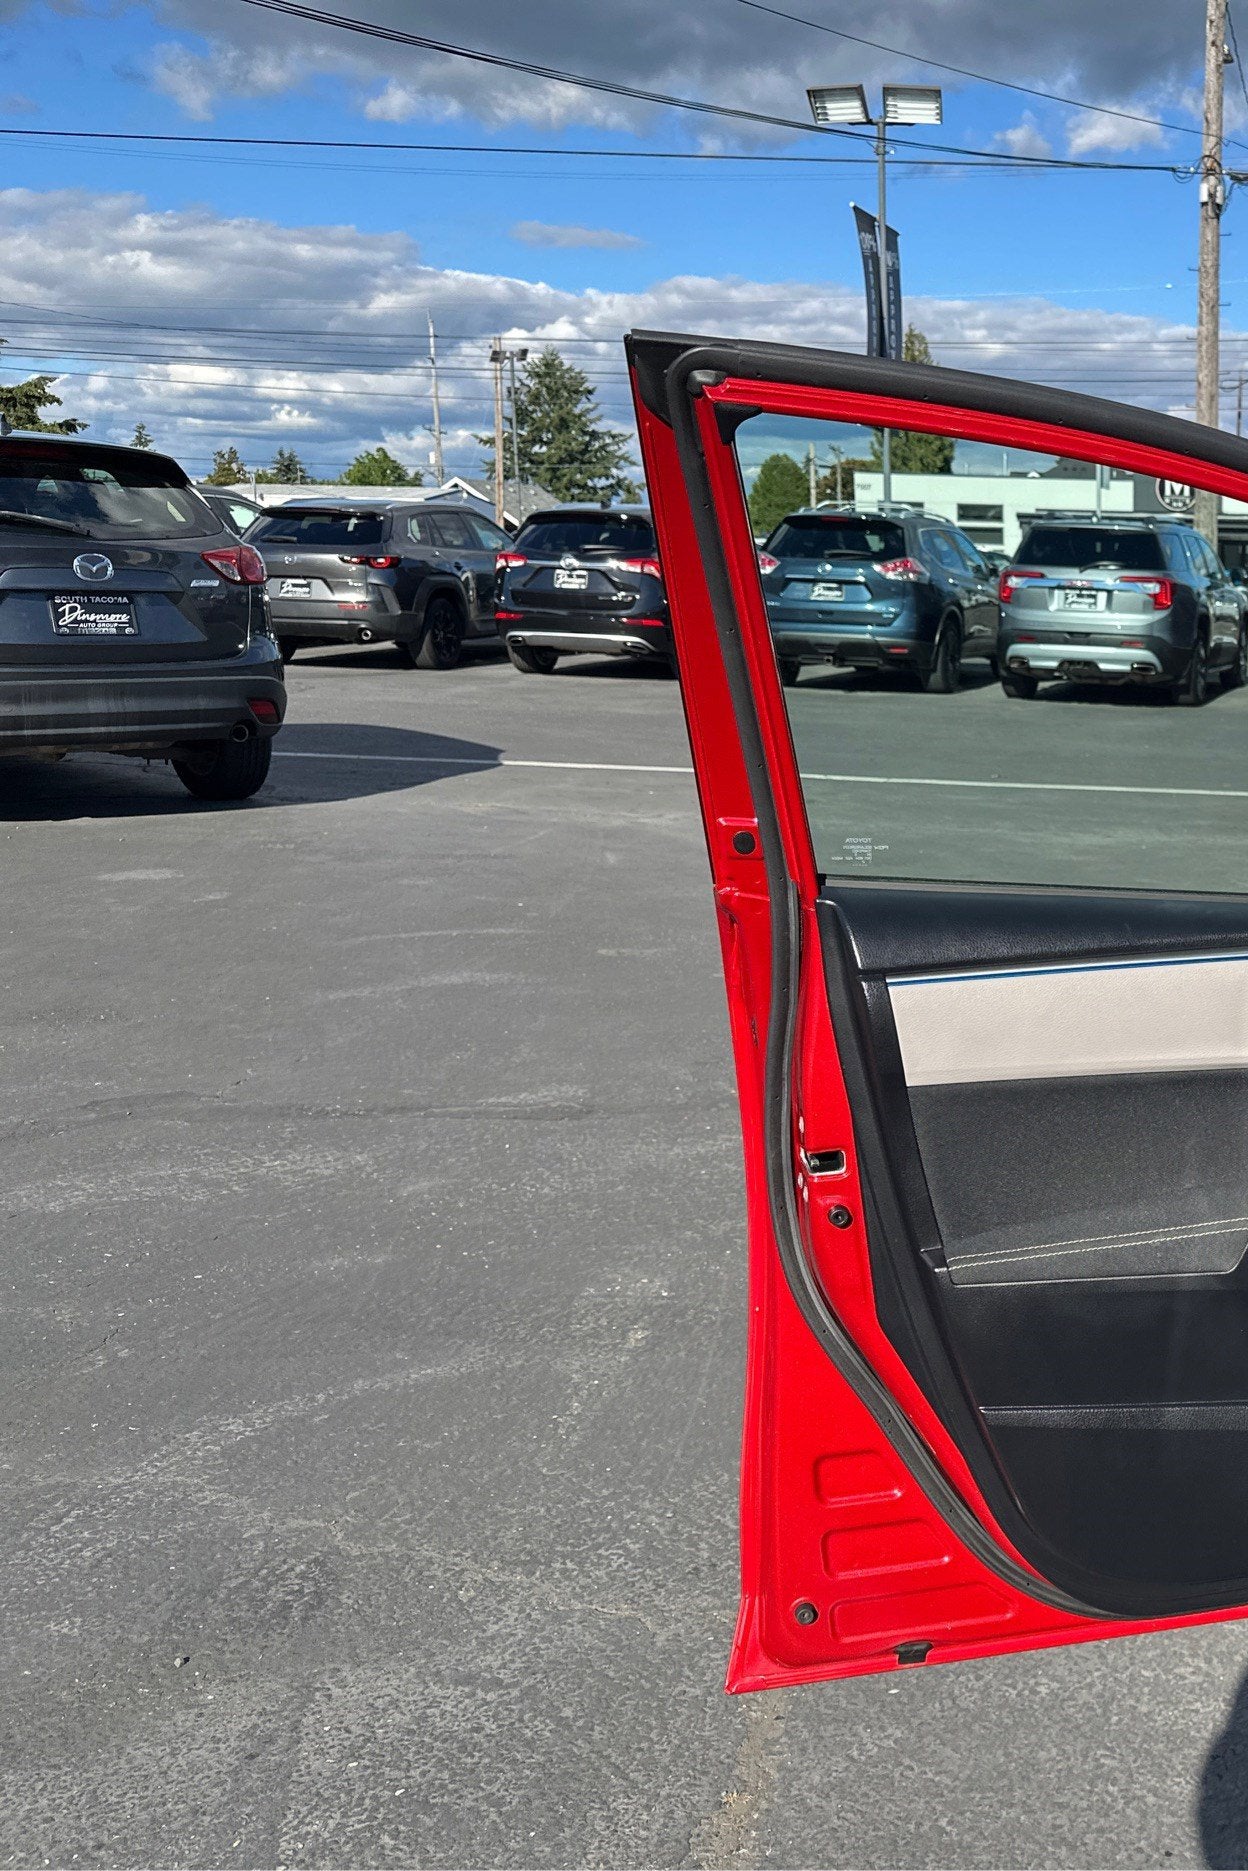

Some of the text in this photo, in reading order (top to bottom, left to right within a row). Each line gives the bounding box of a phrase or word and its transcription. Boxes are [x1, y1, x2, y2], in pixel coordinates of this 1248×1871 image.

[54, 595, 129, 604] SOUTH TACOMA
[57, 603, 130, 626] Dinsmore
